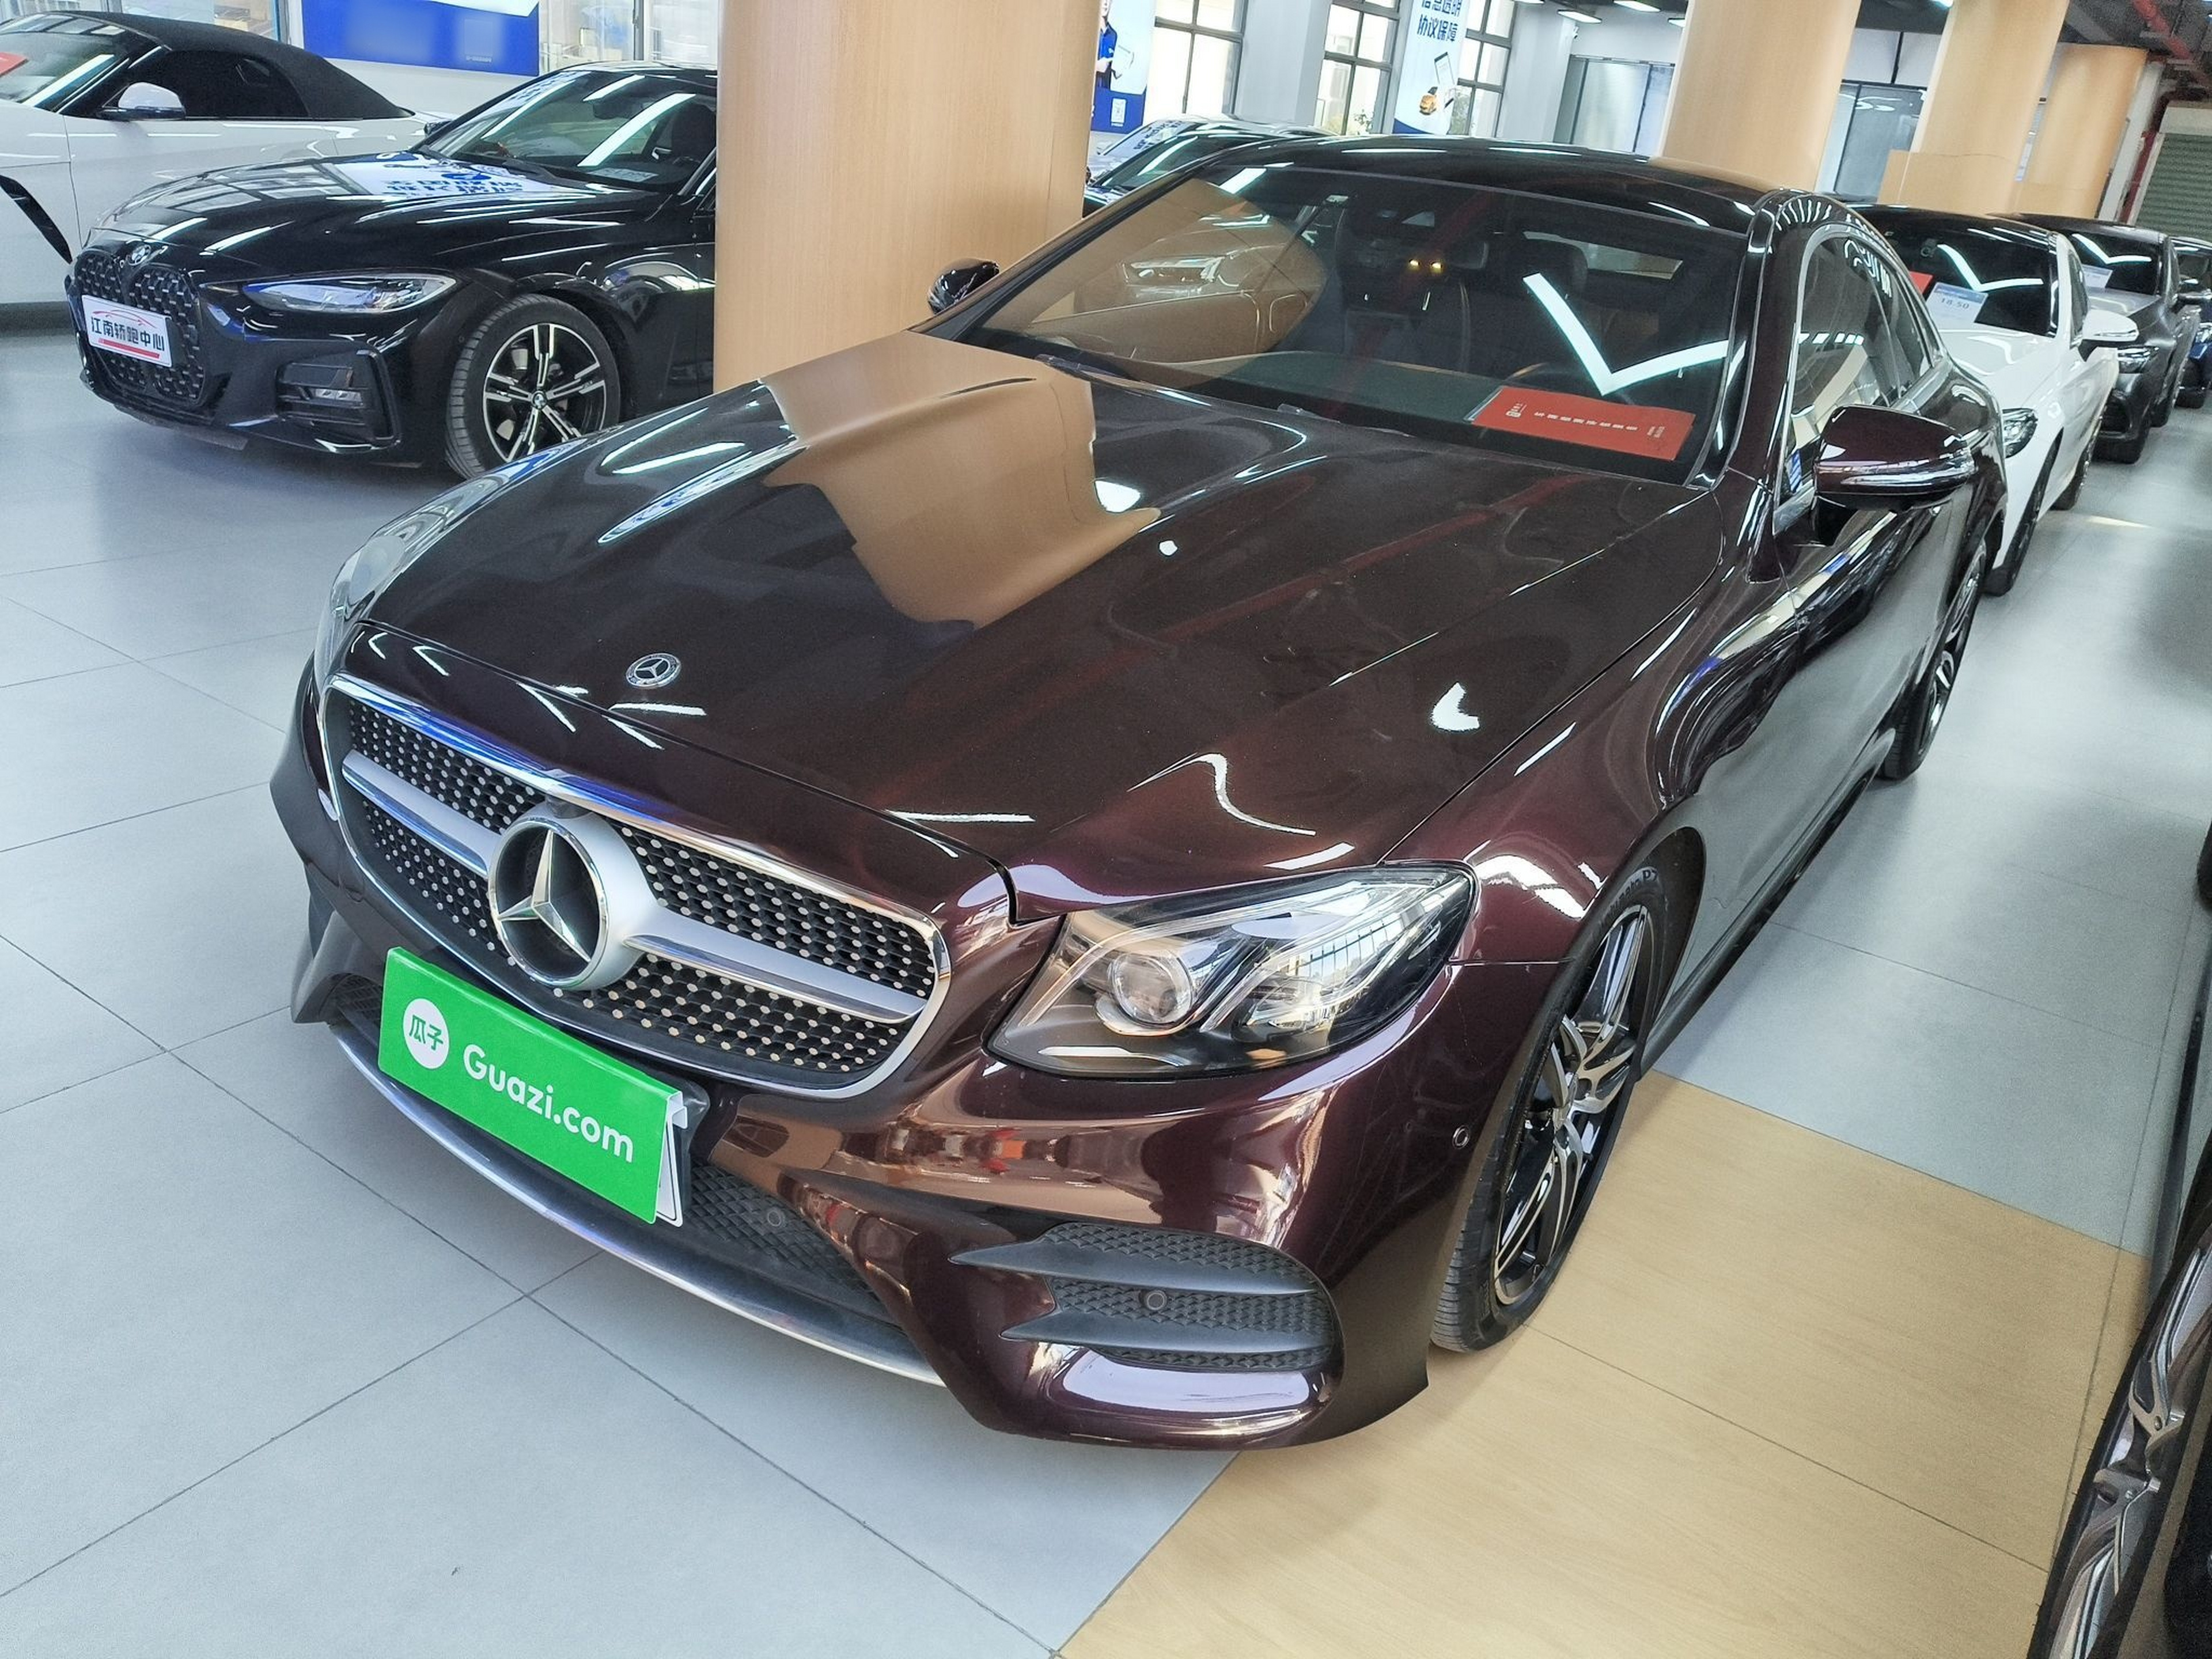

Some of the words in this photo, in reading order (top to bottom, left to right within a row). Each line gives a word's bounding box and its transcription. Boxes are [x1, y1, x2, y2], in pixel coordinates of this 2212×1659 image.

[1417, 14, 1459, 43] 协议保障
[91, 317, 165, 351] 江南轿跑中心
[409, 1014, 444, 1051] 瓜子
[463, 1044, 634, 1163] Guazi.com
